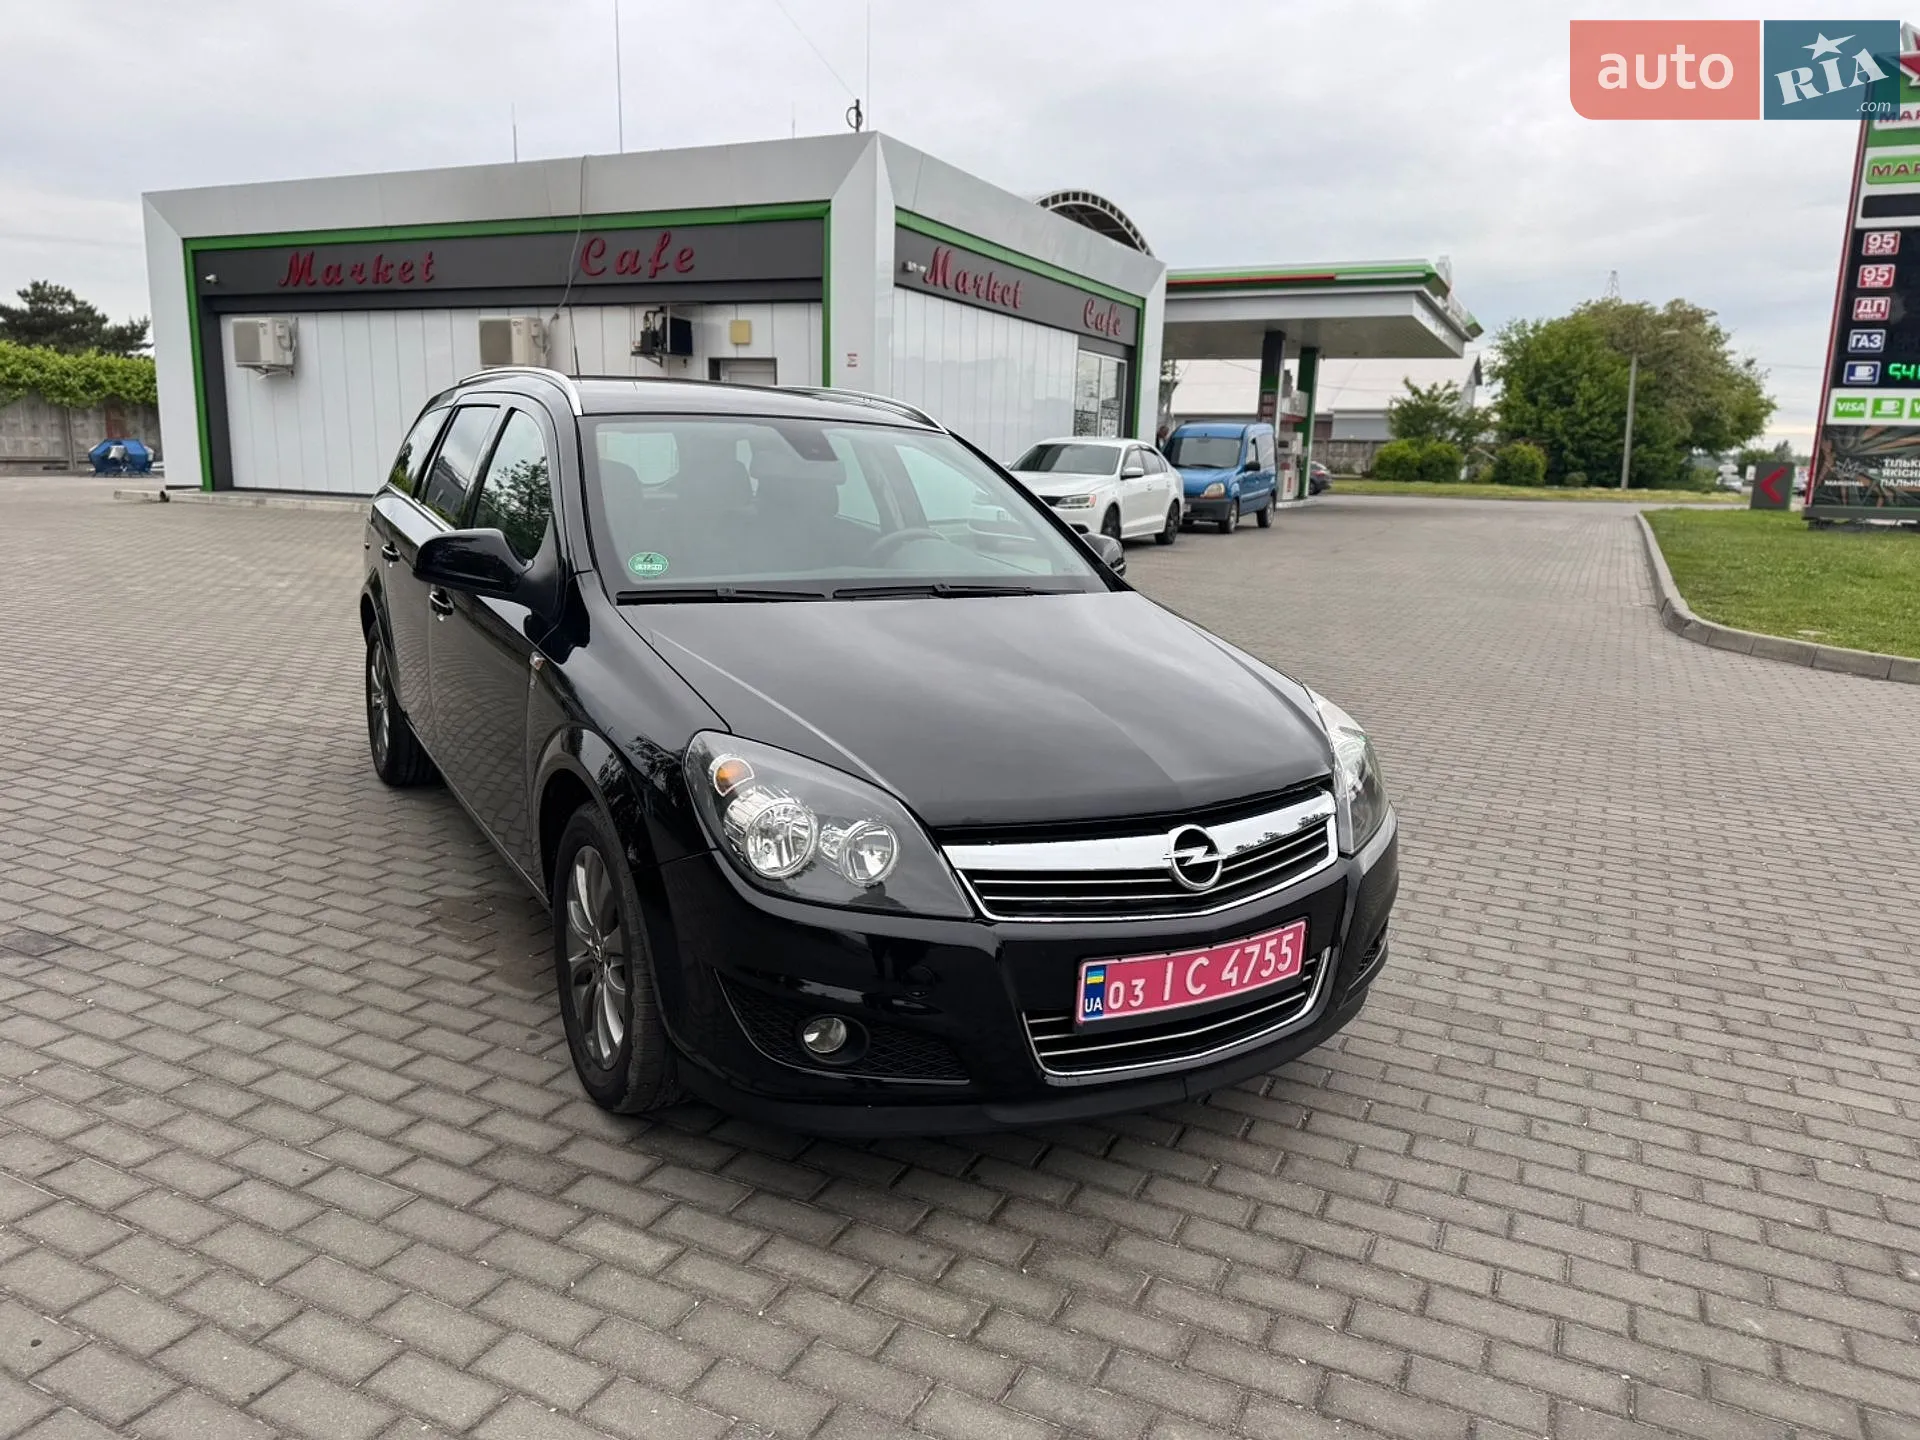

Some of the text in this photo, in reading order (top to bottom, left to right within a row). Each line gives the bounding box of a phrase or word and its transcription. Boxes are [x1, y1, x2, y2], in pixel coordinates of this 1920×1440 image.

[1867, 234, 1896, 249] 95
[278, 230, 696, 287] Market Cafe
[1863, 267, 1890, 281] 95
[922, 246, 1122, 337] Market Cafe
[1857, 300, 1886, 313] ДП
[1851, 334, 1881, 348] ГАЗ
[1837, 402, 1865, 412] VISA
[1107, 978, 1145, 1010] 03
[1220, 933, 1294, 987] 4755
[1084, 997, 1103, 1013] UA
